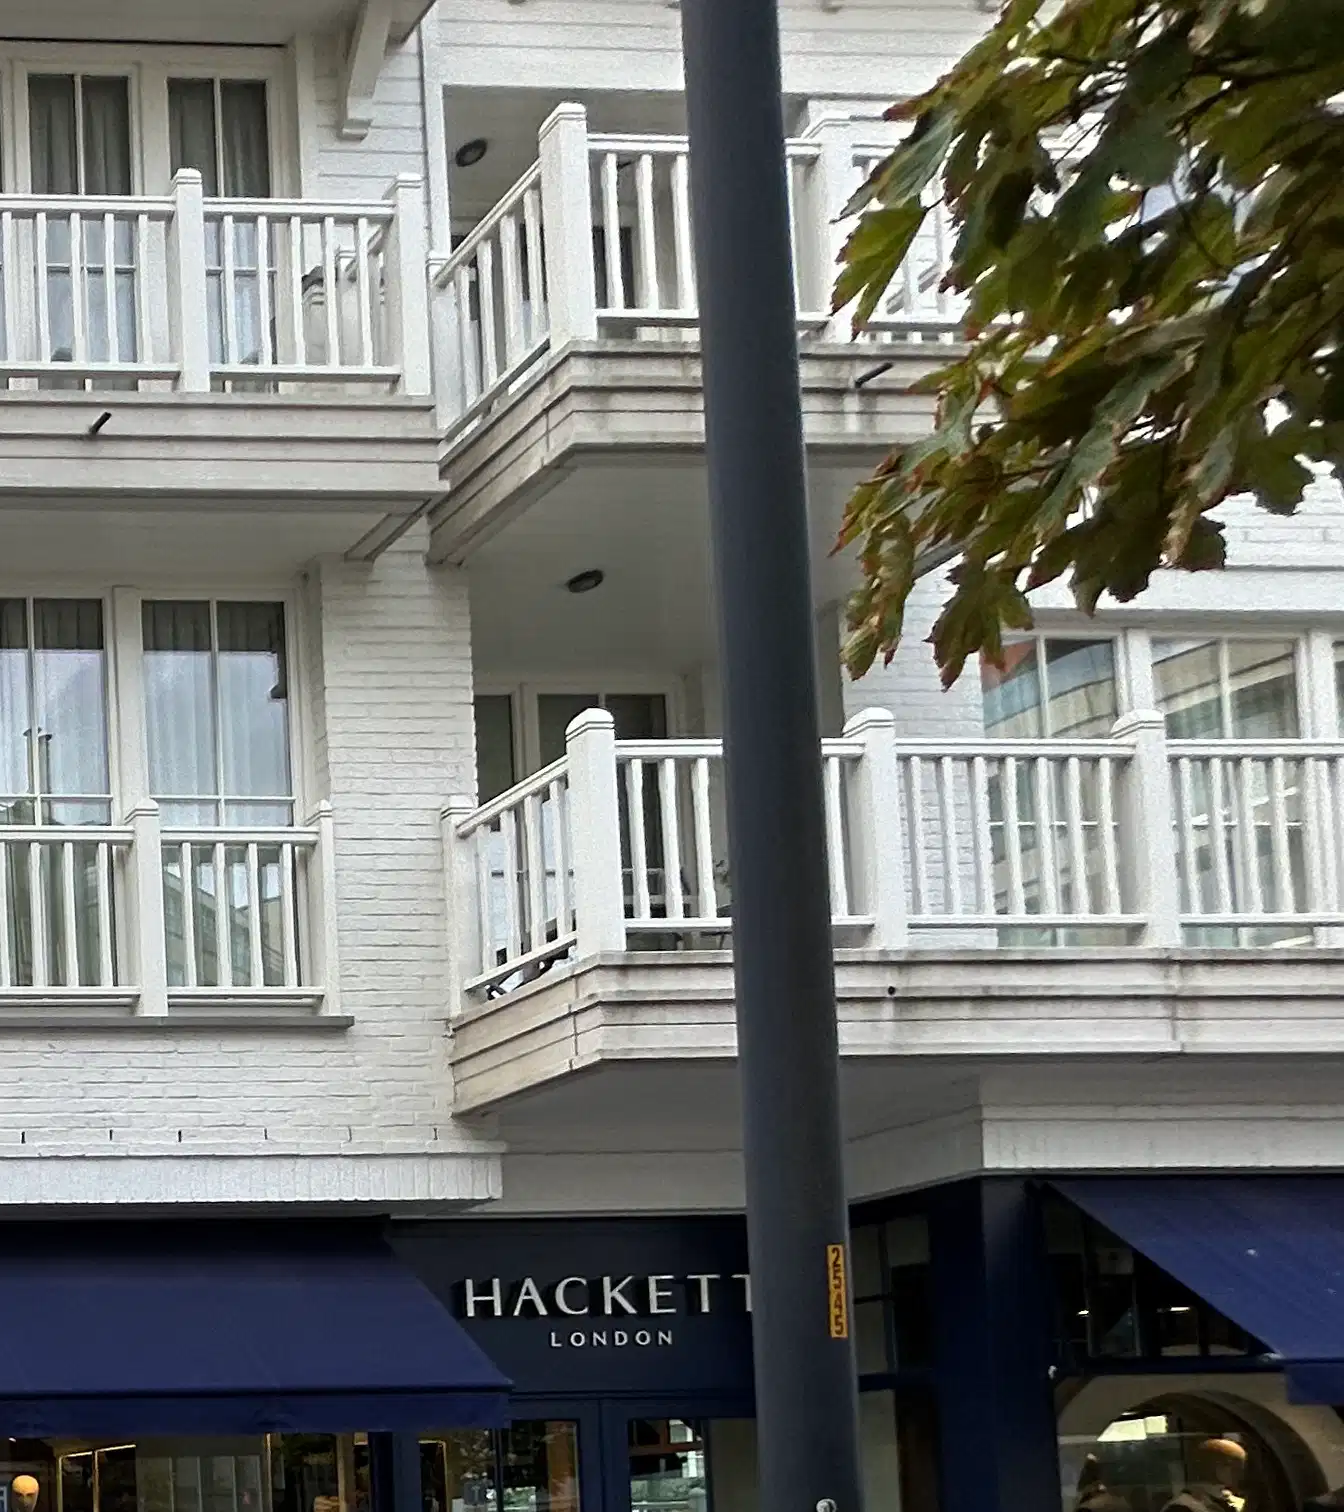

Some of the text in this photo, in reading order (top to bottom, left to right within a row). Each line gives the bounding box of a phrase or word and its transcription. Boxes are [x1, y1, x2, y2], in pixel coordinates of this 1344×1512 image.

[465, 1274, 752, 1317] HACKETT
[831, 1246, 844, 1335] 2545
[550, 1330, 673, 1348] LONDON
